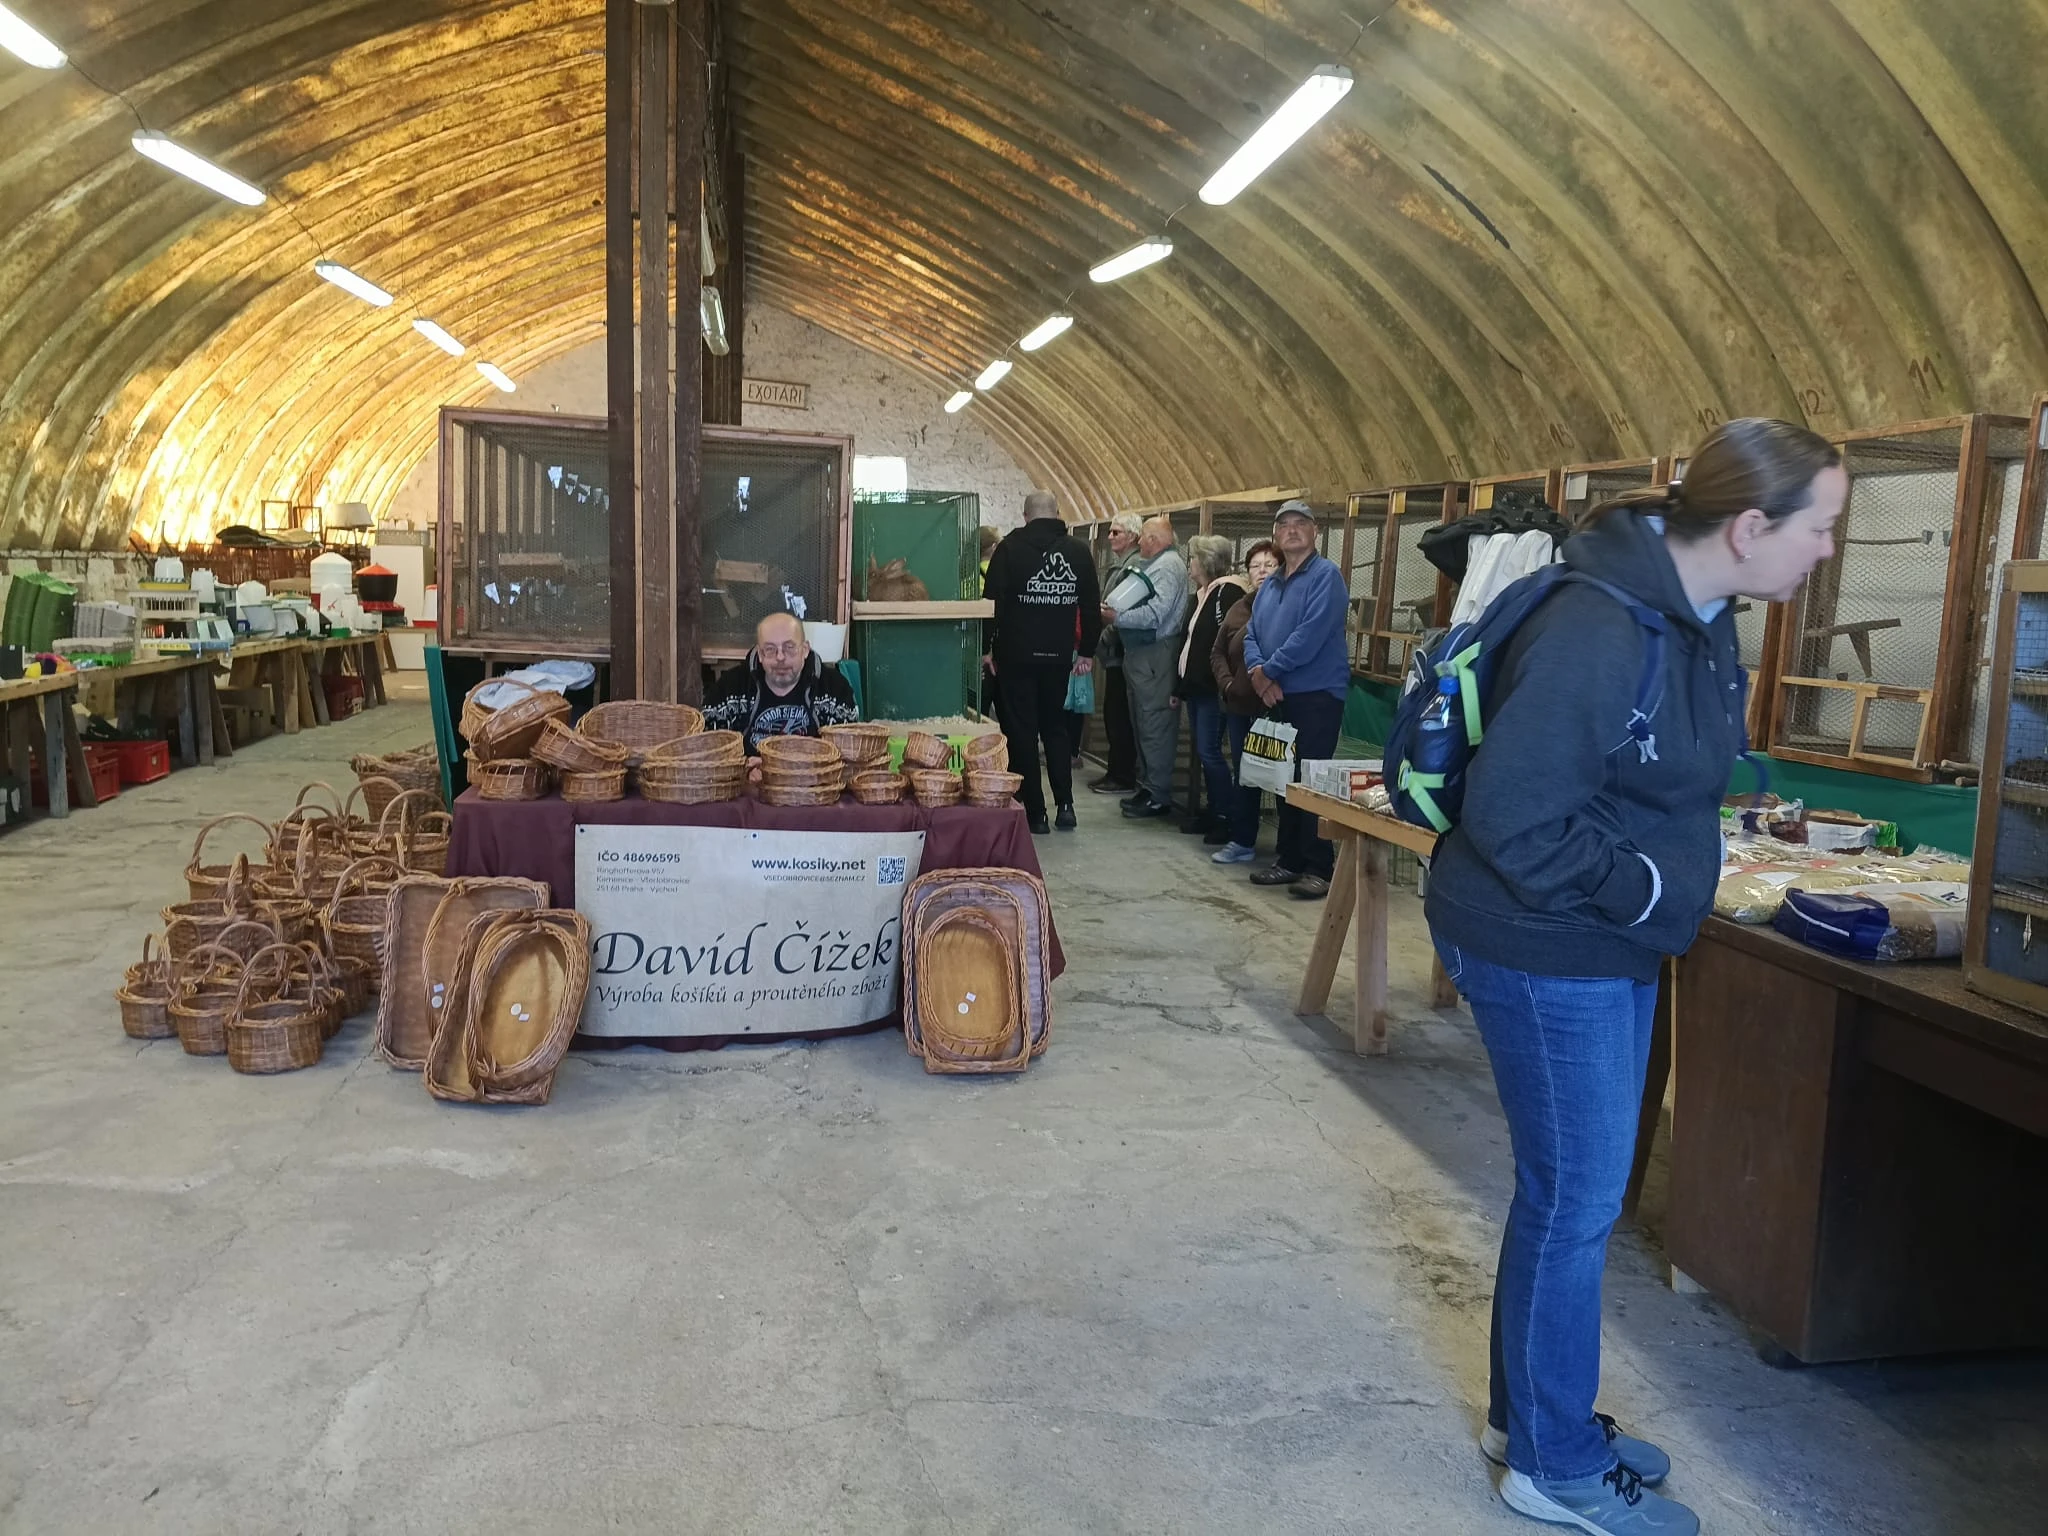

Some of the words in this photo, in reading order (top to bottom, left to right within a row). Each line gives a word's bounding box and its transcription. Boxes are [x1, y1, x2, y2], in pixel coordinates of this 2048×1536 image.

[1026, 580, 1076, 595] Kappa
[1017, 594, 1060, 605] TRAINING
[597, 850, 620, 862] IČO
[623, 852, 681, 863] 48696595
[751, 856, 866, 873] www.kosiky.net
[774, 916, 898, 974] Čížek
[595, 982, 663, 1011] Výroba
[671, 982, 728, 1003] košíků
[734, 991, 745, 1003] a
[745, 978, 846, 1010] proutěného
[851, 974, 889, 996] zboží
